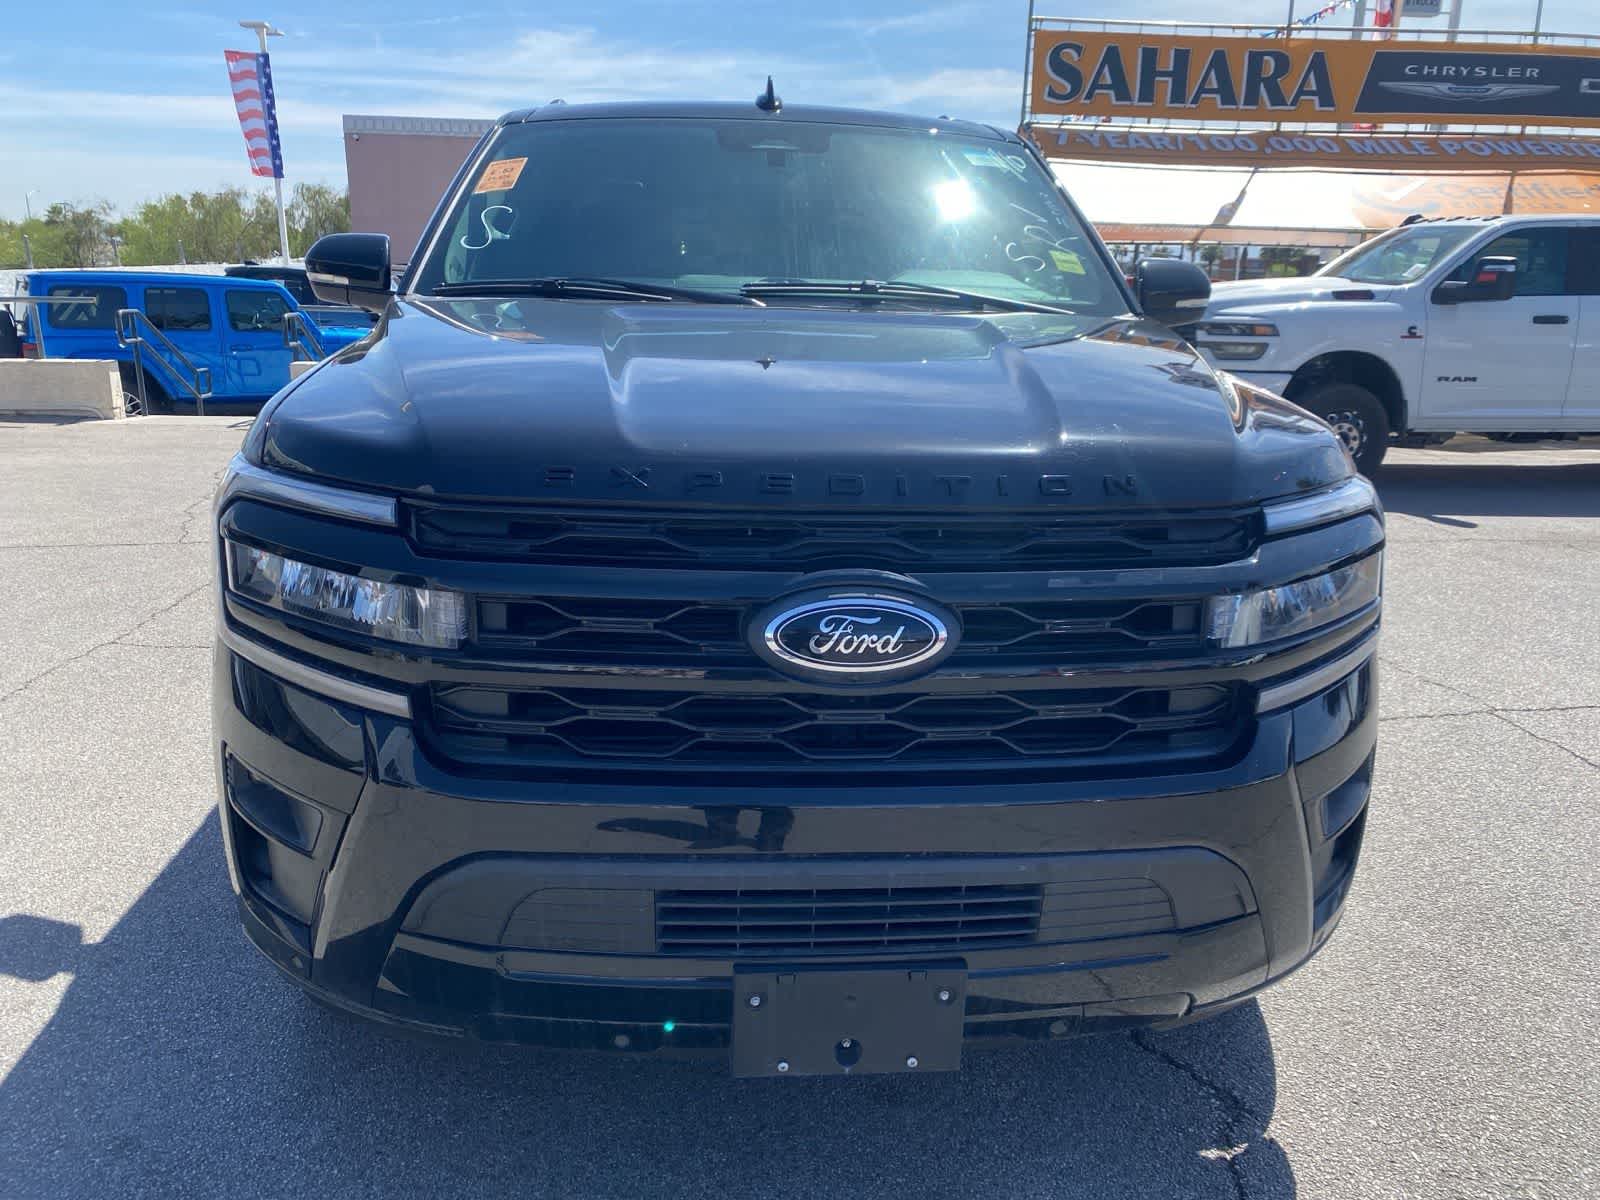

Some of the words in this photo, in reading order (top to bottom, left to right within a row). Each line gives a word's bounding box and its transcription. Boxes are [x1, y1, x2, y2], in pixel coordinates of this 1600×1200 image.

[1044, 41, 1336, 111] SAHARA
[1404, 64, 1540, 78] CHRYSLER
[1345, 139, 1438, 157] MILE
[543, 464, 1137, 497] EXPEDITION
[809, 614, 905, 654] Ford
